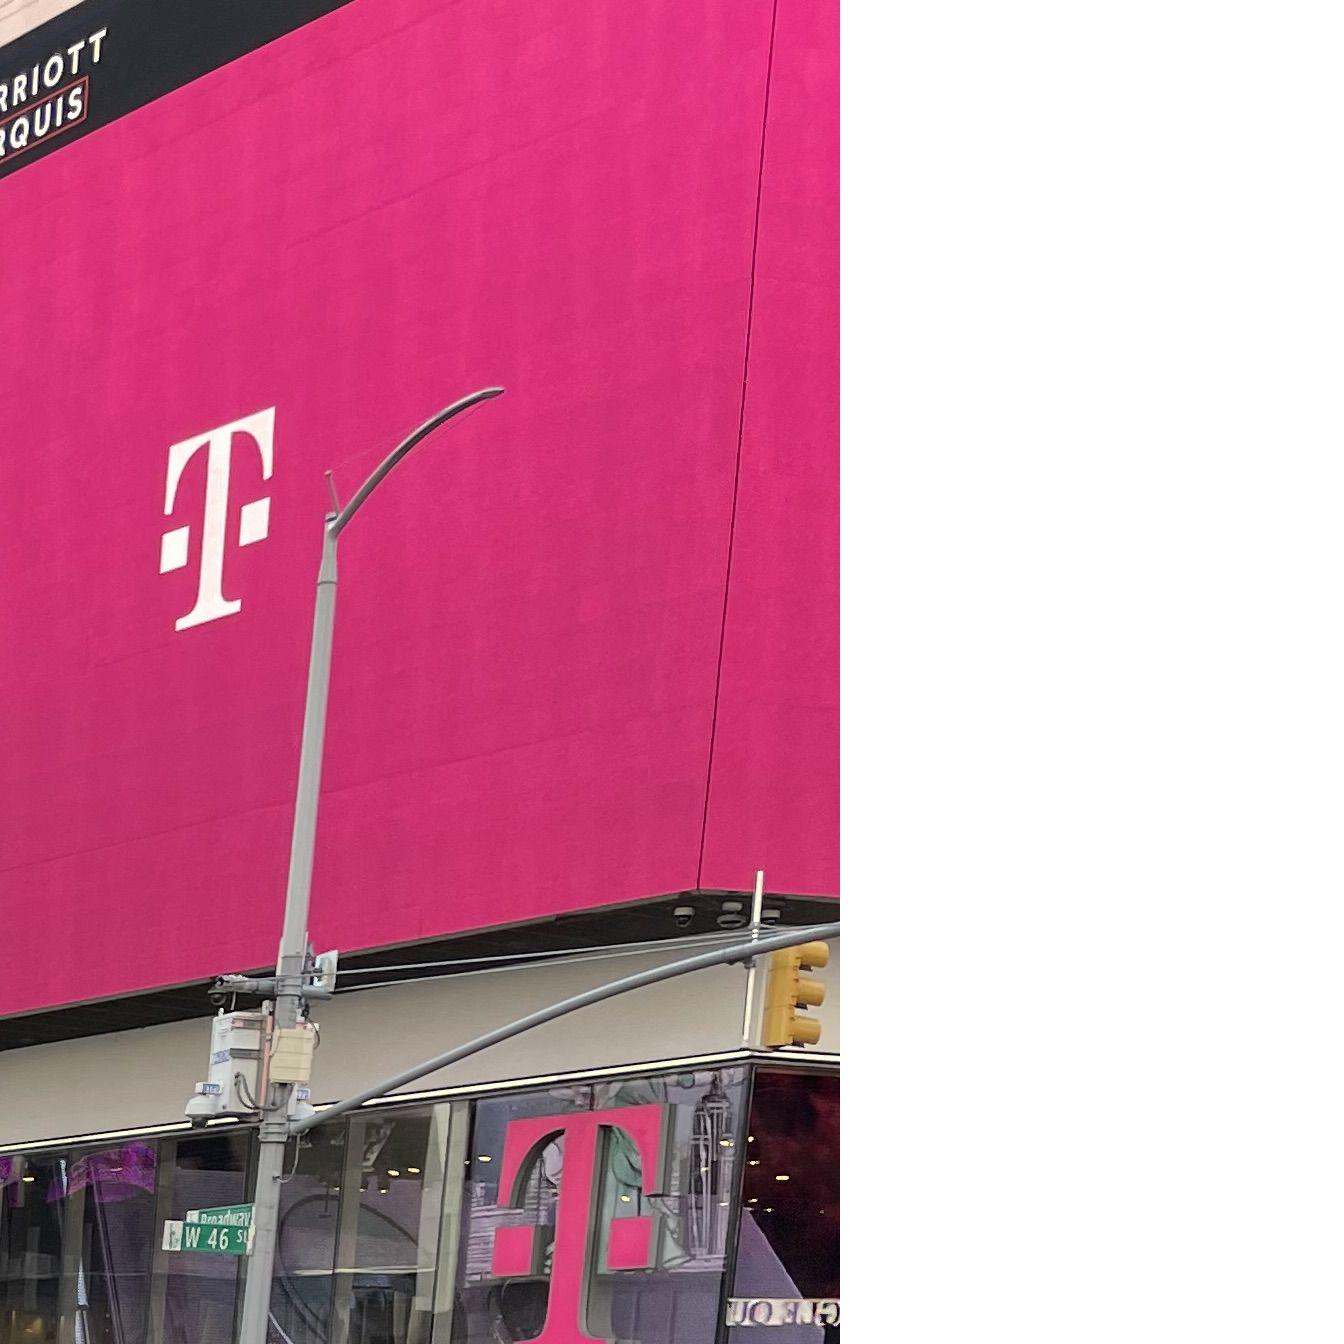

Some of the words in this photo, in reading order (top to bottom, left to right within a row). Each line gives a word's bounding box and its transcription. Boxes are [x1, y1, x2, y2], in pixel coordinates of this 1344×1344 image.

[200, 1210, 251, 1226] Broadway
[185, 1226, 201, 1248] W
[207, 1228, 229, 1250] 46
